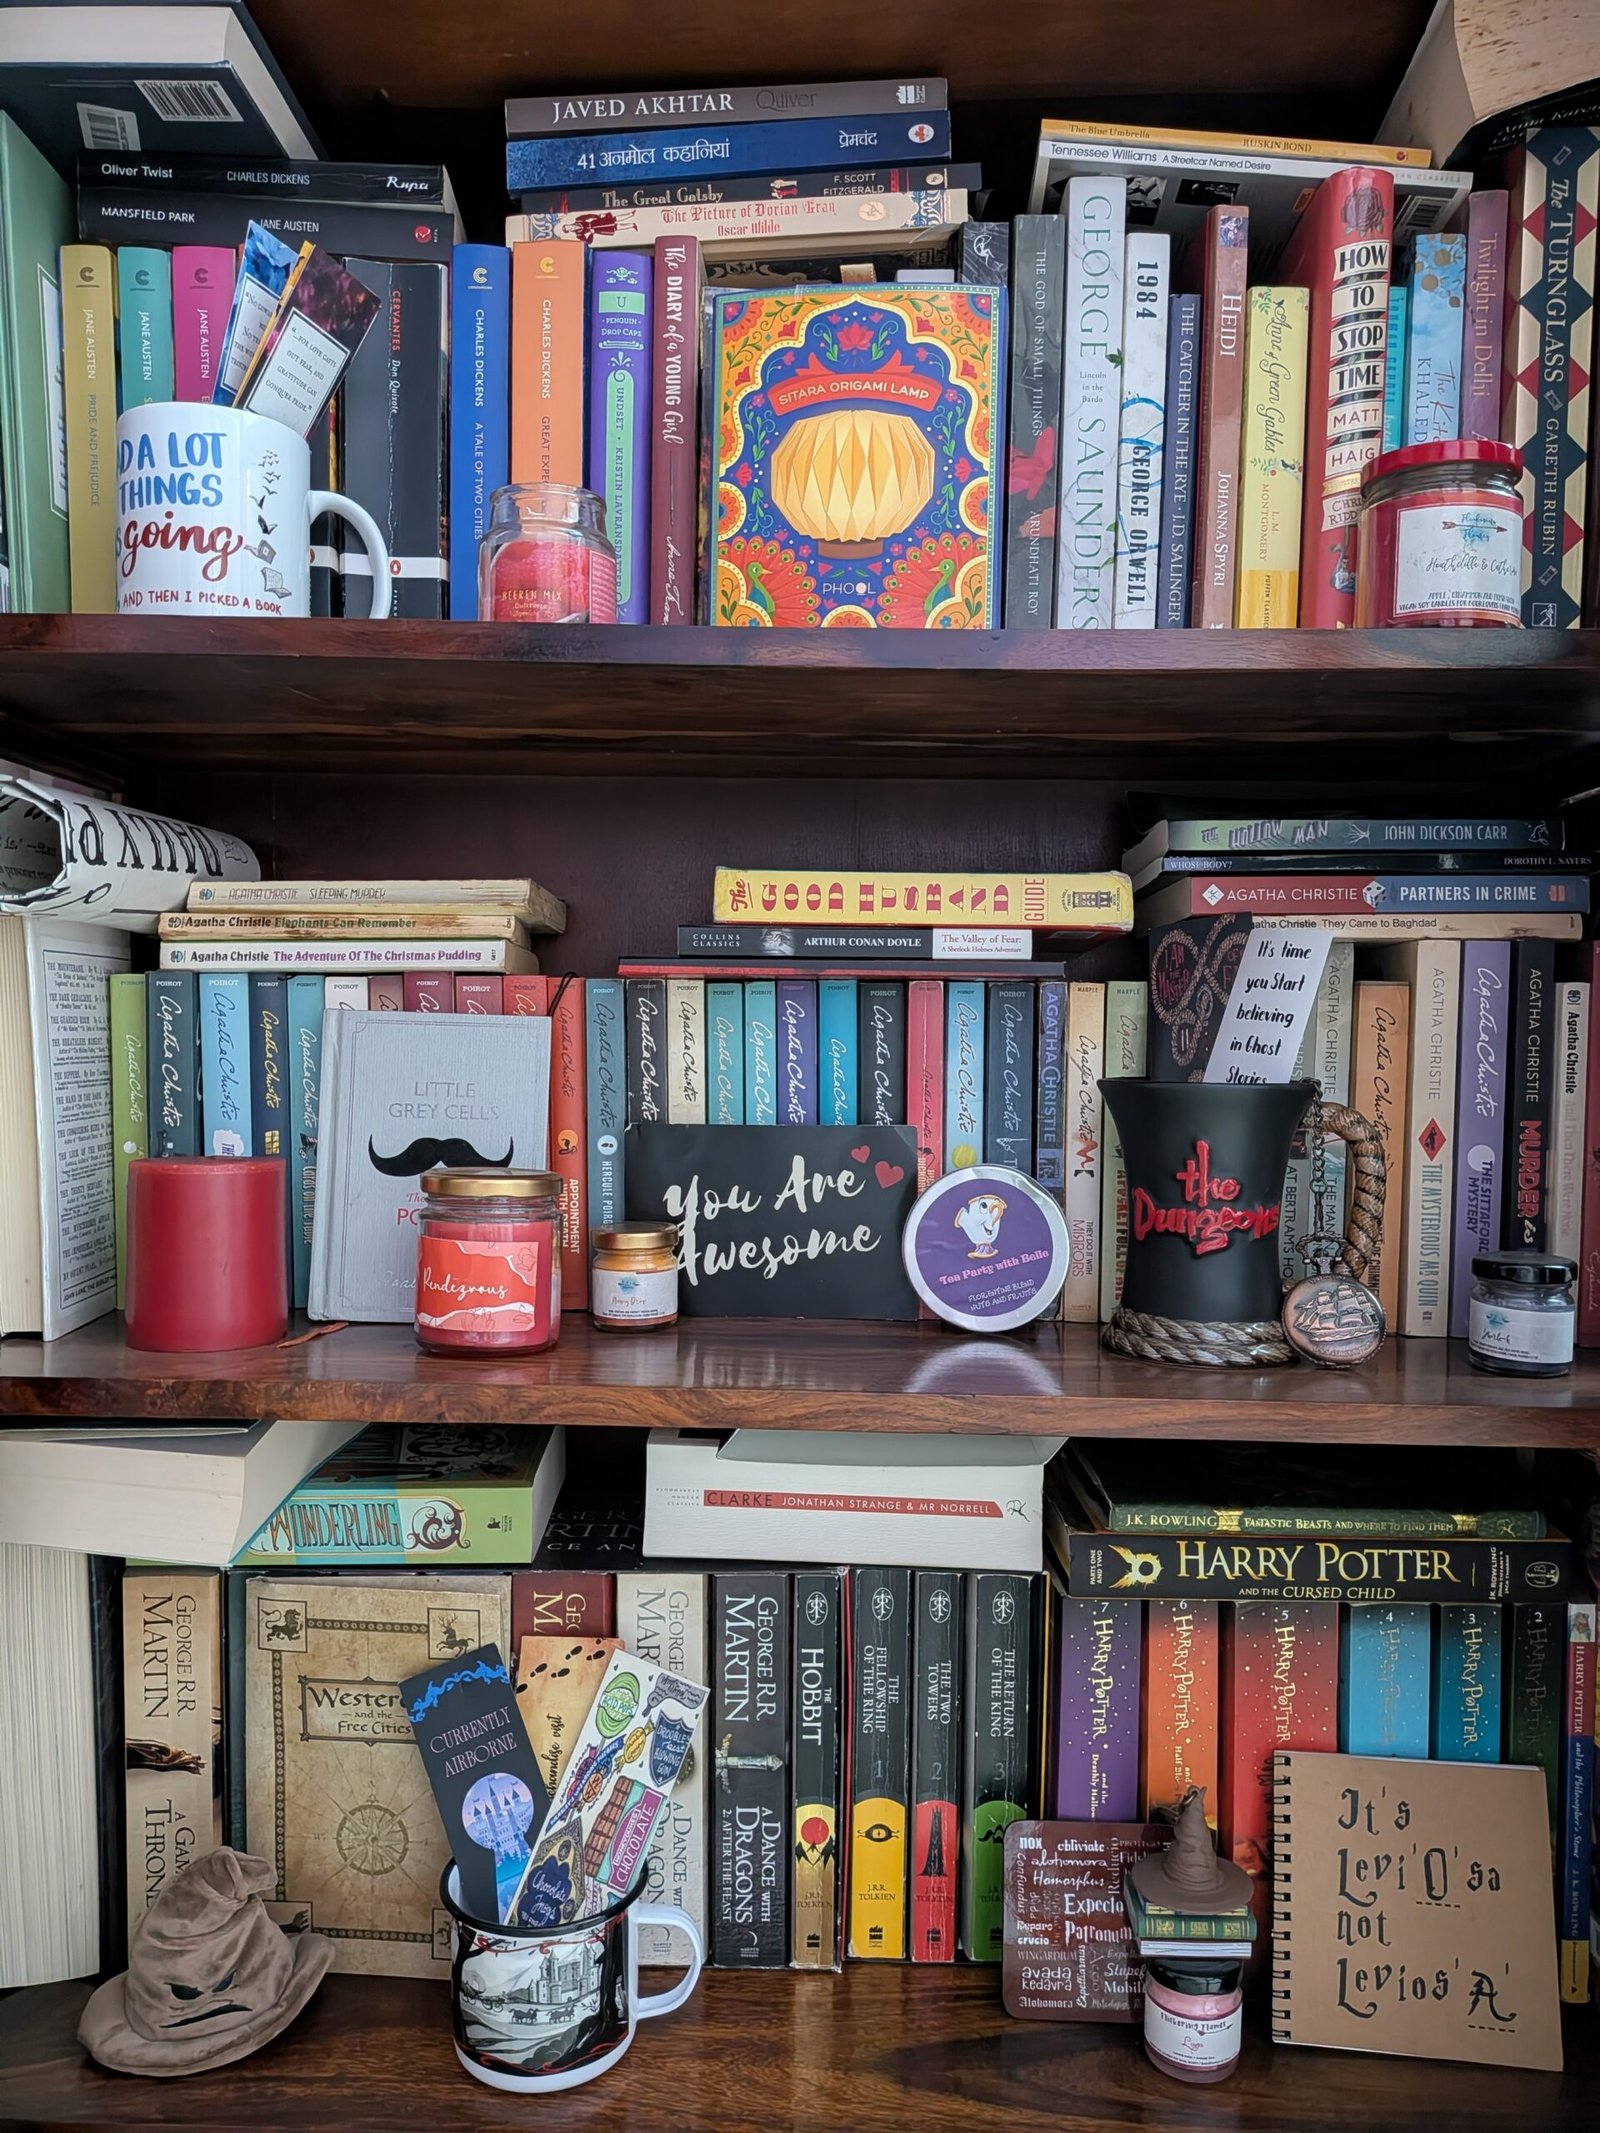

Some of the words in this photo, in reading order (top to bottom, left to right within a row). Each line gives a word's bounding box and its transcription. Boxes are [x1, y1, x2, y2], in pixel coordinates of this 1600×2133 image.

[552, 98, 626, 125] JAVED
[634, 93, 735, 116] AKHTAR
[756, 89, 818, 112] Quiver
[576, 153, 596, 170] 41
[598, 148, 657, 168] अनमोल
[662, 138, 731, 163] कहानियां
[838, 130, 878, 150] प्रेमचंद
[1051, 144, 1109, 160] Tennessee
[1112, 147, 1157, 163] Williams
[101, 164, 138, 177] Oliver
[141, 166, 173, 178] Twist
[1170, 155, 1207, 167] Streetcar
[1208, 157, 1243, 169] Named
[1245, 159, 1271, 171] Desire
[226, 170, 268, 184] CHARLES
[270, 171, 310, 186] DICKENS
[602, 191, 630, 208] The
[633, 190, 671, 205] Great
[673, 185, 724, 205] Gatsby
[1550, 179, 1570, 209] The
[101, 208, 166, 221] MANSFIELD
[168, 210, 195, 223] PARK
[661, 208, 689, 224] The
[692, 205, 737, 222] Picture
[741, 205, 753, 218] of
[755, 202, 799, 218] Dorian
[717, 221, 748, 236] Oscar
[751, 221, 781, 234] Wilde
[1339, 243, 1388, 272] HOW
[1079, 195, 1113, 357] GEORGE
[1135, 261, 1159, 320] 1984
[1350, 284, 1374, 308] TO
[1543, 213, 1574, 383] TURNGLASS
[1220, 294, 1241, 357] HEIDI
[1336, 326, 1383, 352] STOP
[778, 384, 827, 406] SITARA
[829, 381, 888, 393] ORIGAMI
[890, 383, 929, 400] LAMP
[1335, 365, 1381, 393] TIME
[1333, 409, 1379, 429] MATT
[137, 433, 155, 470] A
[168, 432, 227, 468] LOT
[1331, 448, 1375, 468] HAIG
[1543, 419, 1558, 495] GARETH
[120, 473, 223, 515] THINGS
[1130, 446, 1150, 518] GEORGE
[1072, 417, 1106, 629] SAUNDERS
[1541, 501, 1556, 556] RUBIN
[121, 510, 243, 581] going
[1127, 529, 1148, 606] ORWELL
[123, 591, 142, 608] AND
[148, 590, 179, 602] THEN
[185, 591, 192, 602] I
[200, 592, 239, 607] PICKED
[243, 598, 250, 609] A
[256, 600, 281, 615] BOOK
[730, 879, 748, 912] The
[761, 882, 844, 914] GOOD
[859, 881, 1008, 914] HUSBAND
[1023, 878, 1045, 922] GUIDE
[1227, 888, 1288, 901] AGATHA
[1291, 888, 1358, 901] CHRISTIE
[1400, 886, 1471, 901] PARTNERS
[1475, 886, 1490, 900] IN
[1494, 886, 1537, 900] CRIME
[804, 936, 847, 947] ARTHUR
[849, 937, 884, 947] CONAN
[887, 937, 922, 948] DOYLE
[942, 934, 959, 944] The
[962, 934, 988, 946] Valley
[991, 934, 1000, 944] of
[1258, 941, 1275, 957] It's
[1281, 942, 1312, 960] time
[190, 950, 227, 963] Agatha
[230, 950, 269, 962] Christie
[273, 951, 292, 961] The
[294, 950, 346, 963] Adventure
[348, 950, 361, 961] Of
[364, 950, 382, 961] The
[384, 950, 435, 961] Christmas
[438, 949, 481, 962] Pudding
[1246, 977, 1267, 994] you
[1270, 976, 1305, 992] Start
[1236, 1007, 1294, 1028] believing
[1231, 1037, 1243, 1052] in
[1246, 1036, 1282, 1056] Ghost
[414, 1081, 476, 1098] LITTLE
[388, 1103, 437, 1120] GREY
[444, 1104, 499, 1120] CELLS
[1176, 1140, 1239, 1205] the
[664, 1175, 761, 1230] You
[775, 1155, 866, 1213] Are
[939, 1273, 960, 1286] Tea
[962, 1265, 994, 1283] Party
[995, 1258, 1019, 1271] with
[1020, 1248, 1050, 1265] Belle
[993, 1295, 1006, 1305] AND
[1012, 1279, 1035, 1292] BLEND
[707, 1493, 773, 1506] CLARKE
[783, 1496, 844, 1509] JONATHAN
[849, 1499, 901, 1511] STRANGE
[907, 1502, 914, 1511] &
[920, 1502, 936, 1512] MR
[940, 1503, 989, 1513] NORRELL
[271, 1501, 402, 1552] WONDERLING
[1125, 1515, 1148, 1526] J.K.
[1151, 1514, 1217, 1527] ROWLING
[1176, 1540, 1303, 1582] HARRY
[1316, 1542, 1461, 1584] POTTER
[1239, 1587, 1259, 1596] AND
[1262, 1587, 1279, 1596] THE
[1283, 1586, 1342, 1598] CURSED
[1347, 1586, 1395, 1598] CHILD
[757, 1597, 779, 1681] GEORGE
[724, 1594, 755, 1722] MARTIN
[863, 1644, 873, 1666] OF
[992, 1648, 1002, 1668] OF
[1004, 1649, 1016, 1675] THE
[863, 1669, 873, 1696] THE
[888, 1674, 899, 1705] THE
[941, 1660, 952, 1690] THE
[991, 1670, 1001, 1696] THE
[801, 1648, 824, 1746] HOBBIT
[824, 1688, 833, 1704] THE
[876, 1647, 888, 1733] FELLOWSHIP
[927, 1663, 938, 1721] TOWERS
[862, 1698, 872, 1734] RING
[940, 1693, 951, 1725] TWO
[990, 1699, 1001, 1737] KING
[1003, 1676, 1015, 1738] RETURN
[429, 1706, 512, 1755] CURRENTLY
[444, 1733, 518, 1778] AIRBORNE
[761, 1807, 770, 1816] A
[1337, 1785, 1411, 1836] It's
[735, 1806, 759, 1924] DRAGONS
[761, 1820, 780, 1884] DANCE
[760, 1888, 770, 1922] WITH
[1337, 1910, 1392, 1947] not
